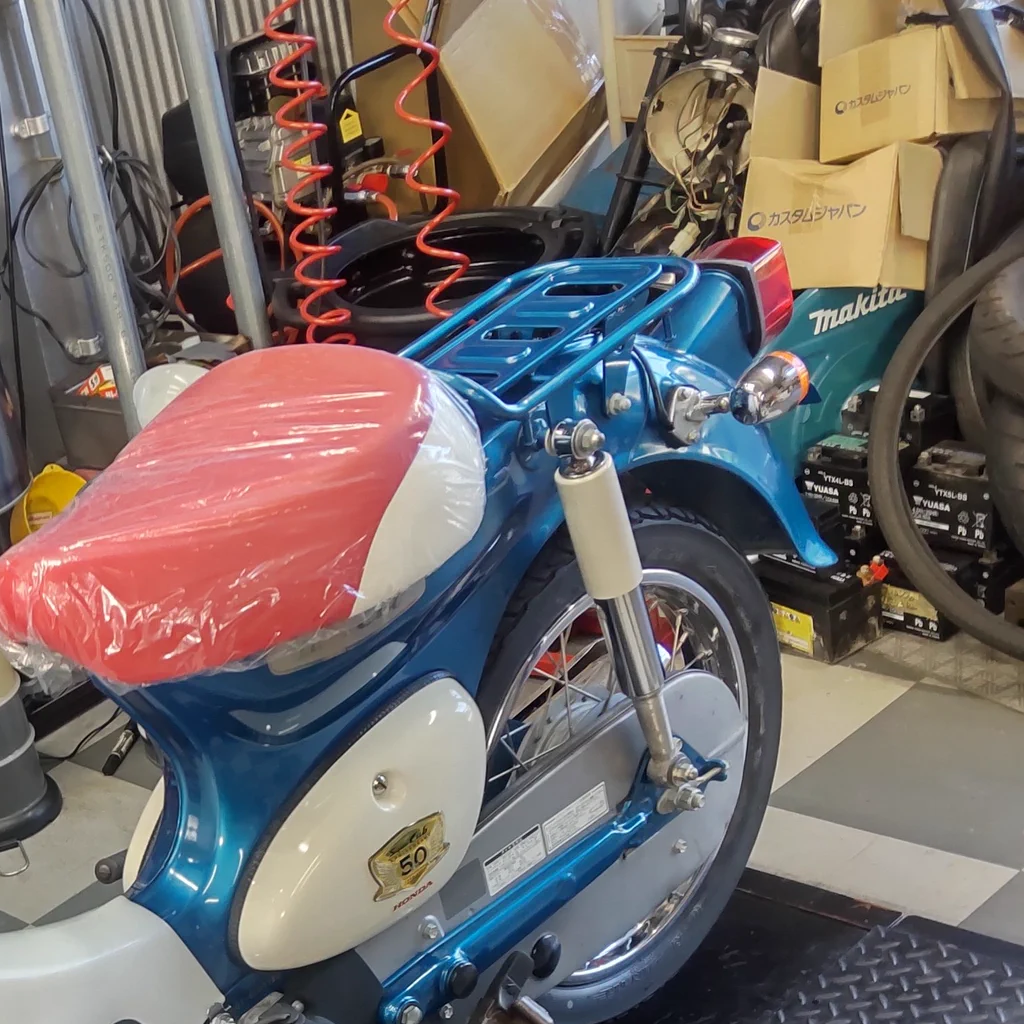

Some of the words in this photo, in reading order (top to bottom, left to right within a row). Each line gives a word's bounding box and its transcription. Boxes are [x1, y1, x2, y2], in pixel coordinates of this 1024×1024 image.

[849, 84, 911, 110] カスタムジャパン
[768, 203, 867, 227] カスタムジャパン
[813, 484, 839, 496] YUASA
[922, 499, 951, 512] YUASA
[957, 525, 967, 537] Pb
[974, 528, 985, 540] Pb
[399, 846, 427, 876] 50
[392, 880, 433, 913] HONDA
